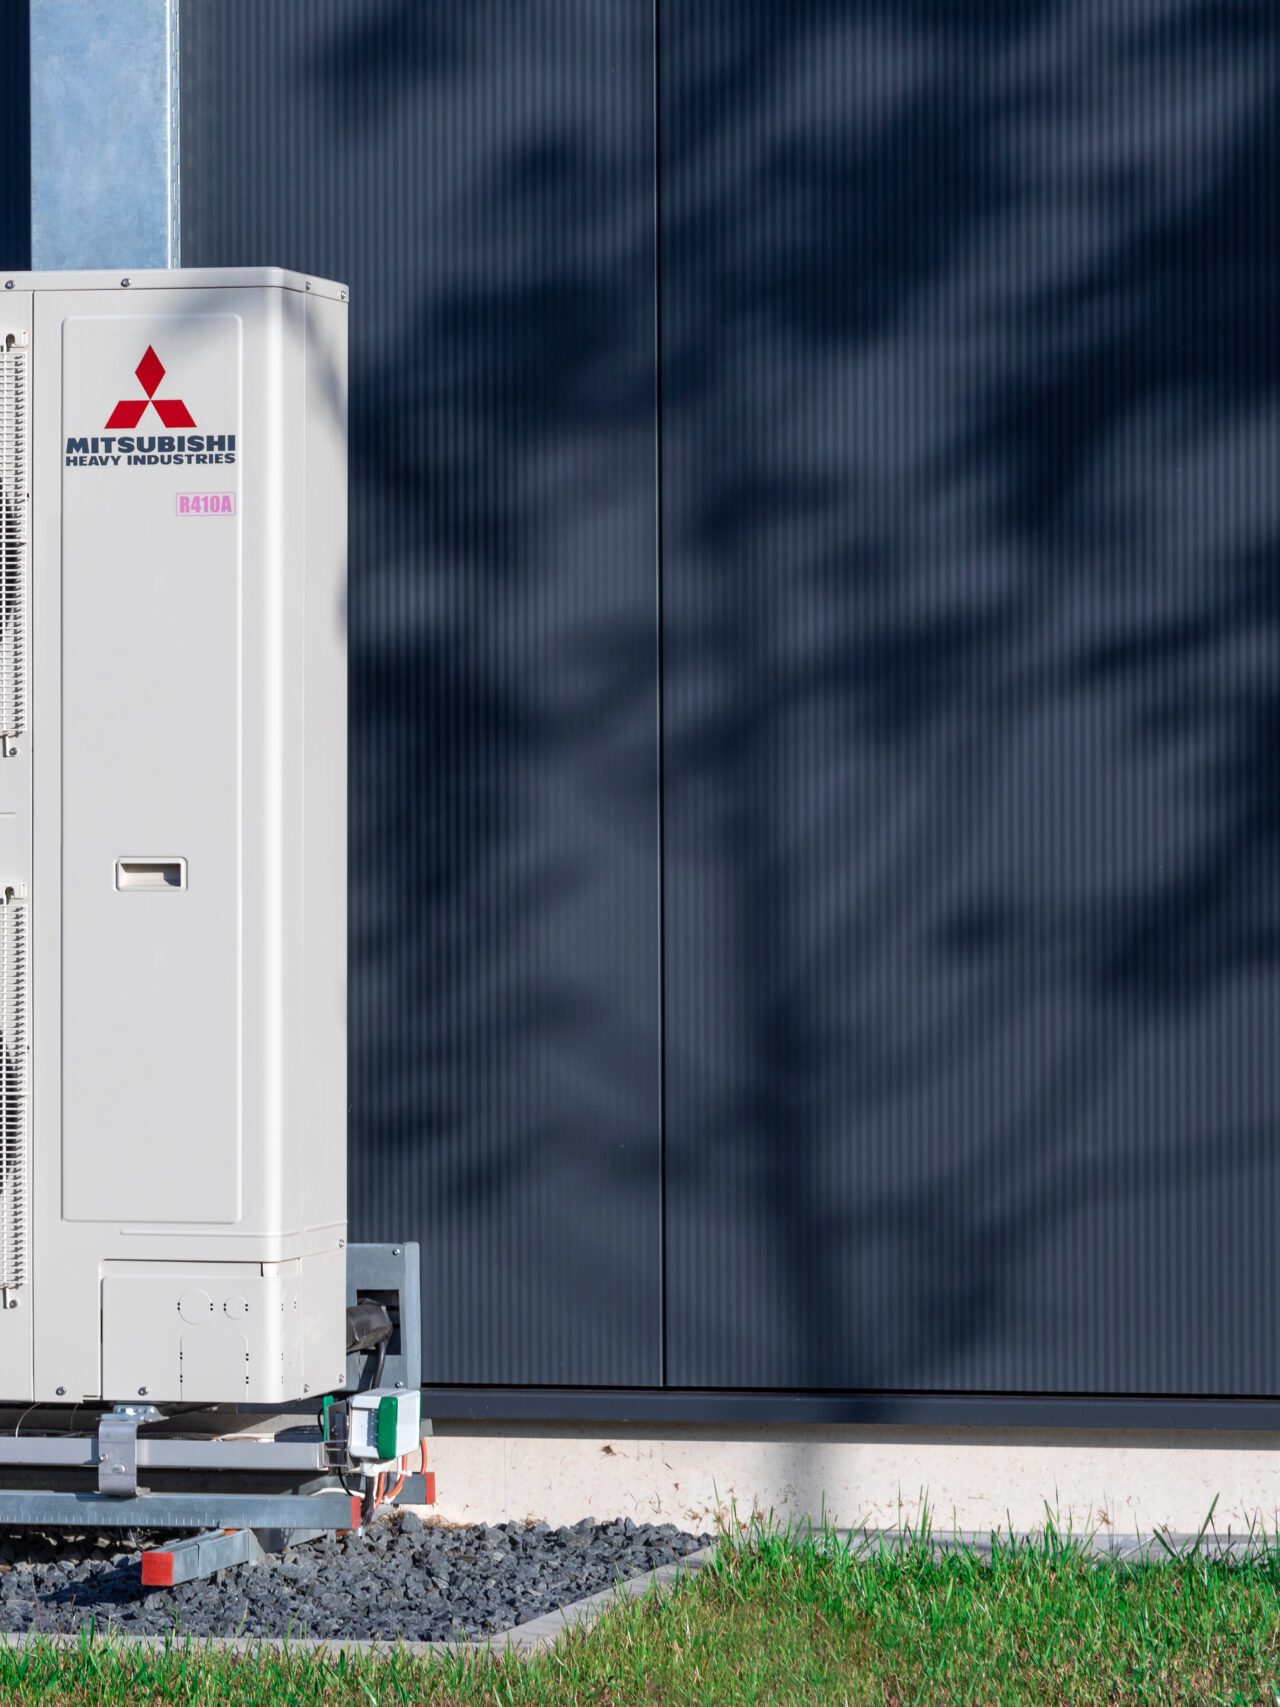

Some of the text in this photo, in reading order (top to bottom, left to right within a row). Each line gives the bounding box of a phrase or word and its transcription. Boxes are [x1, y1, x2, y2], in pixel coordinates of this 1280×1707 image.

[66, 434, 236, 454] MITSUBISHI
[65, 453, 236, 466] HEAVY INDUSTRIES
[179, 495, 232, 513] R410A
